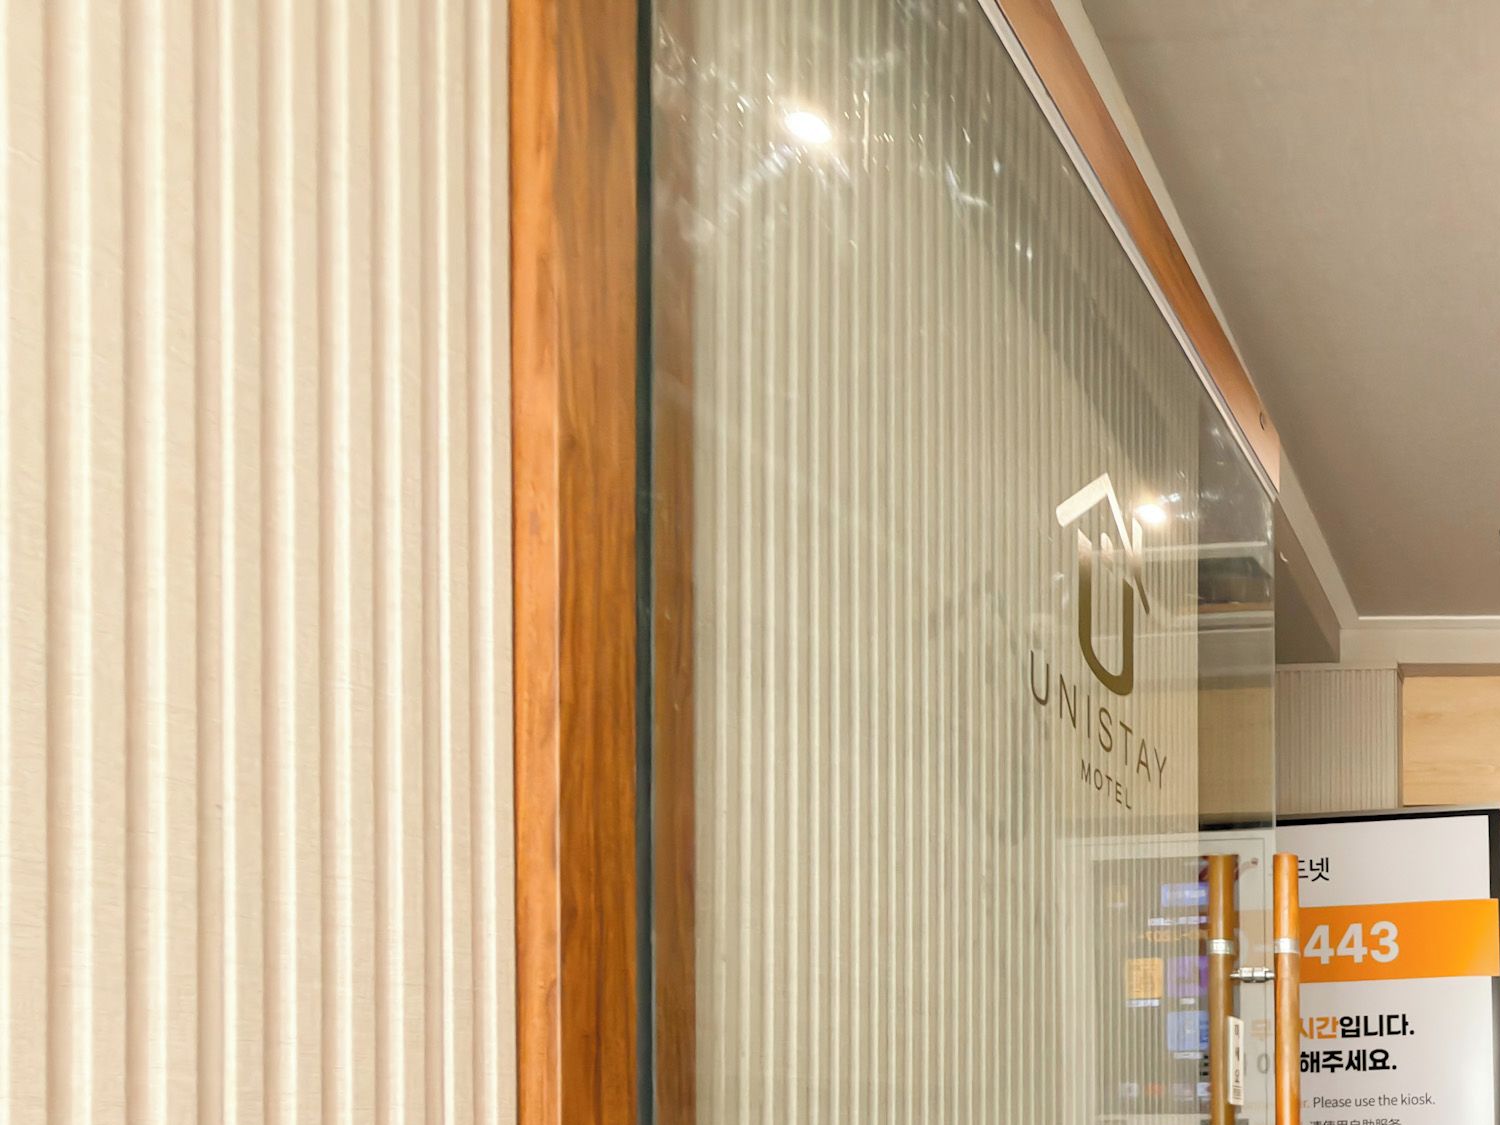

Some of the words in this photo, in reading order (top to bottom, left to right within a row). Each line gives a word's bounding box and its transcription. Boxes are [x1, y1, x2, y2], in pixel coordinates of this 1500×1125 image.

[1030, 650, 1167, 789] UNISTAY
[1081, 758, 1132, 810] MOTEL
[1313, 1096, 1352, 1109] Please
[1354, 1096, 1375, 1107] use
[1378, 1094, 1398, 1106] the
[1401, 1092, 1436, 1106] kiosk.
